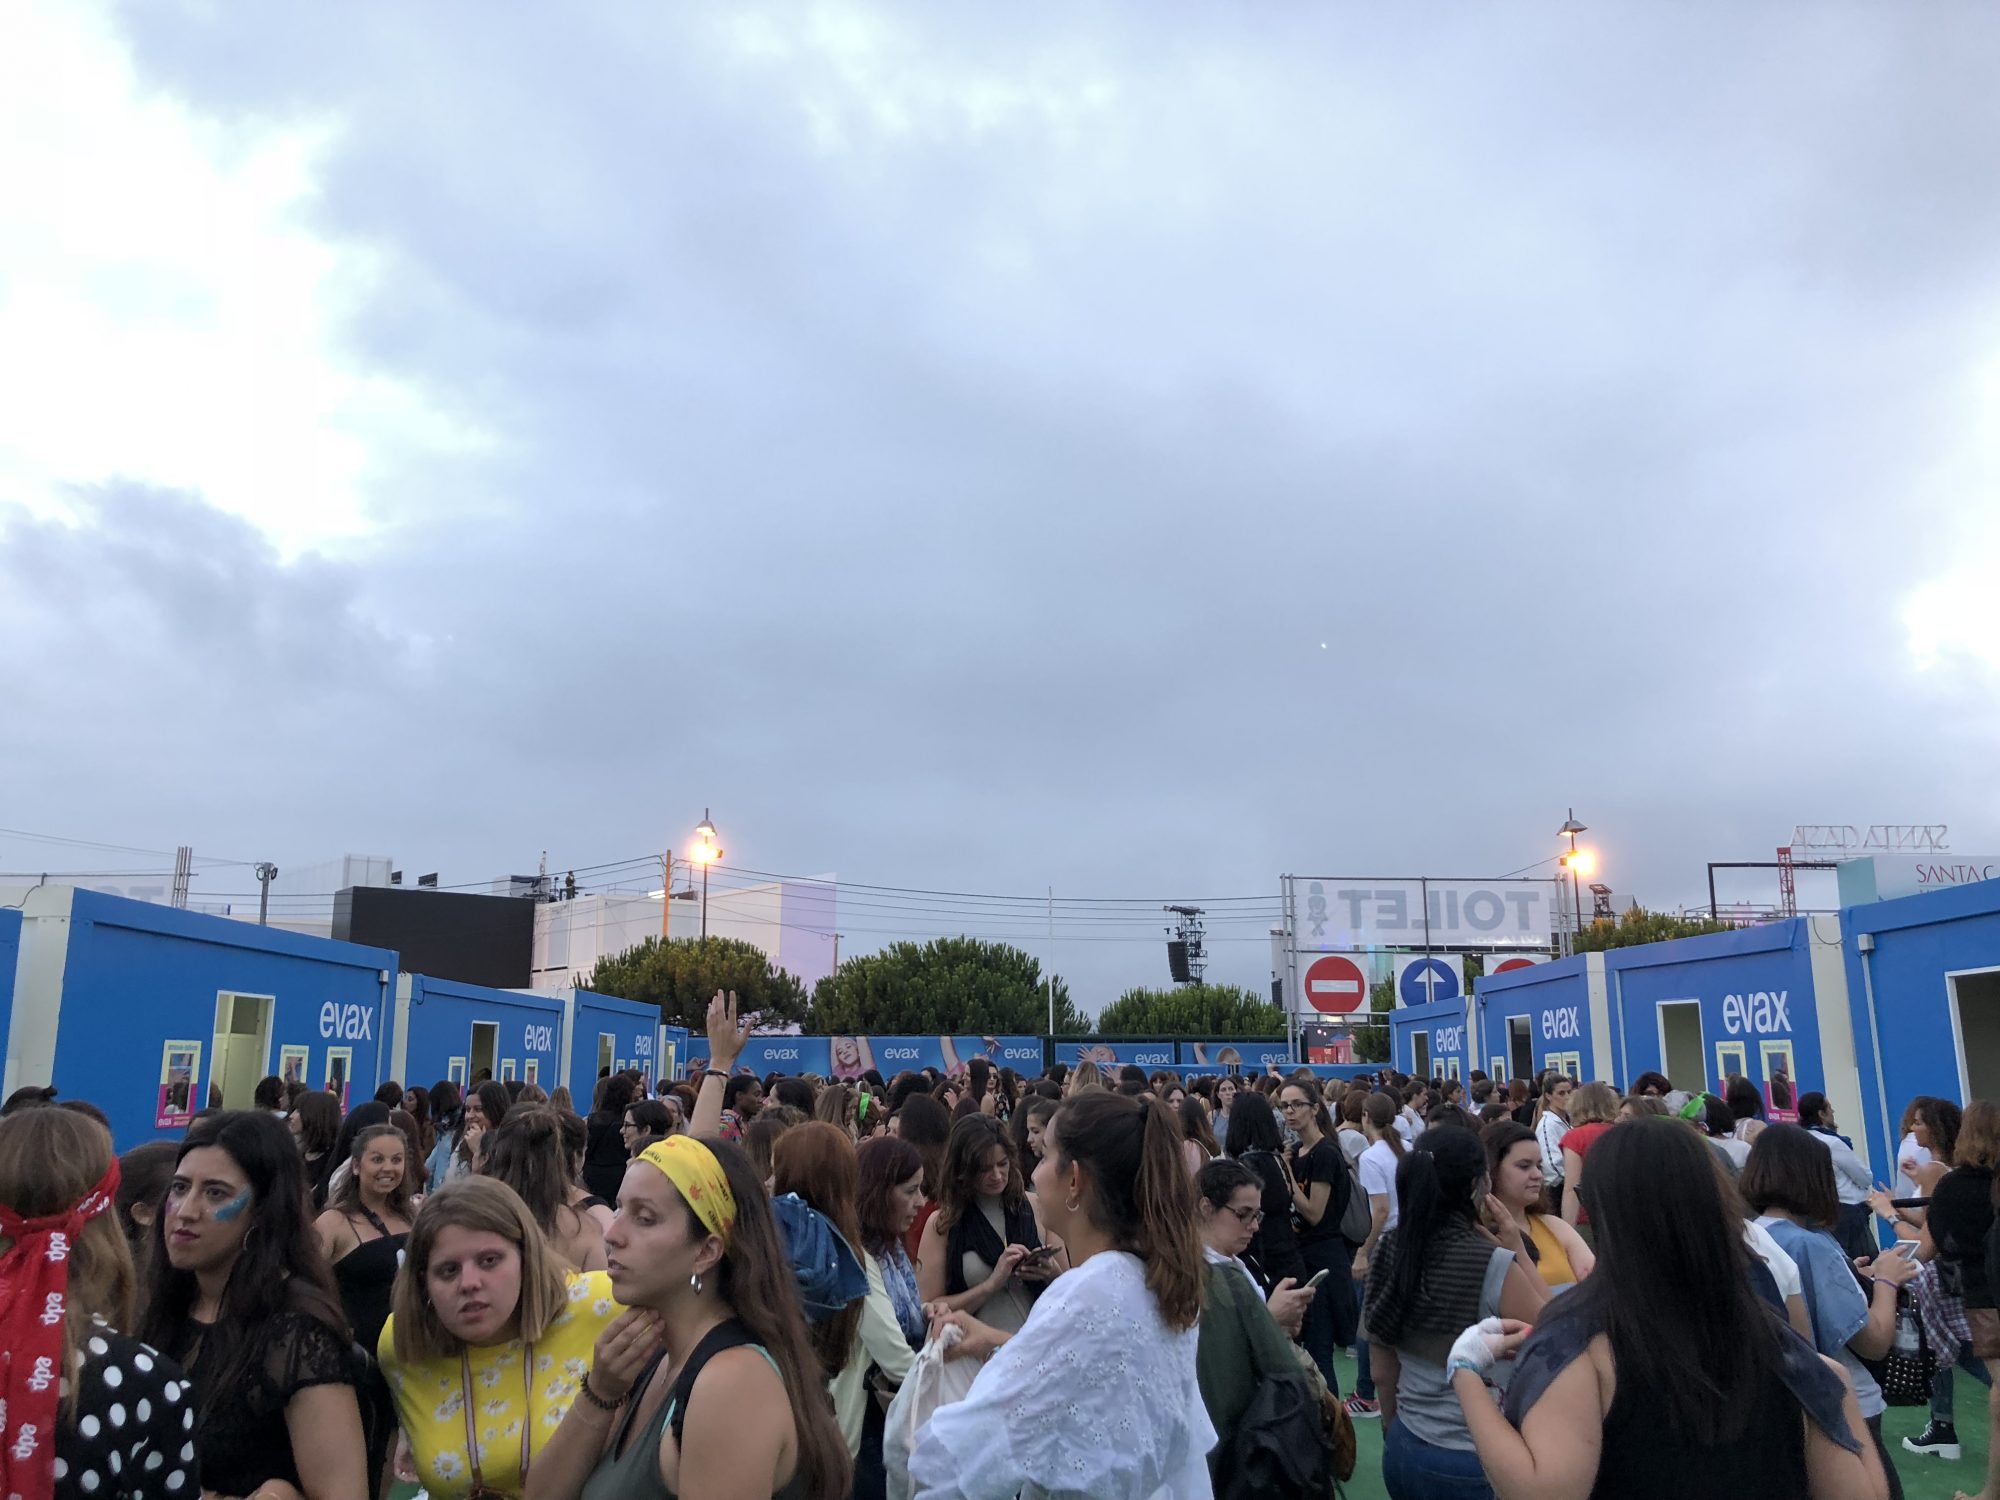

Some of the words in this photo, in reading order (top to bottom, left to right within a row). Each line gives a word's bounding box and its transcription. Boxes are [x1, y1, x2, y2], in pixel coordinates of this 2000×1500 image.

[1916, 864, 1980, 883] SANTA
[319, 1001, 373, 1040] evax
[1542, 1006, 1580, 1039] evax
[1722, 991, 1792, 1034] evax
[524, 1024, 552, 1052] evax
[635, 1034, 653, 1056] evax
[1435, 1026, 1461, 1053] evax
[764, 1046, 799, 1060] evax
[884, 1046, 919, 1059] evax
[1004, 1046, 1039, 1060] evax
[1135, 1052, 1169, 1065] evax
[44, 1231, 71, 1262] edp
[39, 1292, 66, 1326] edp
[27, 1355, 55, 1392] edp
[10, 1422, 39, 1461] edp
